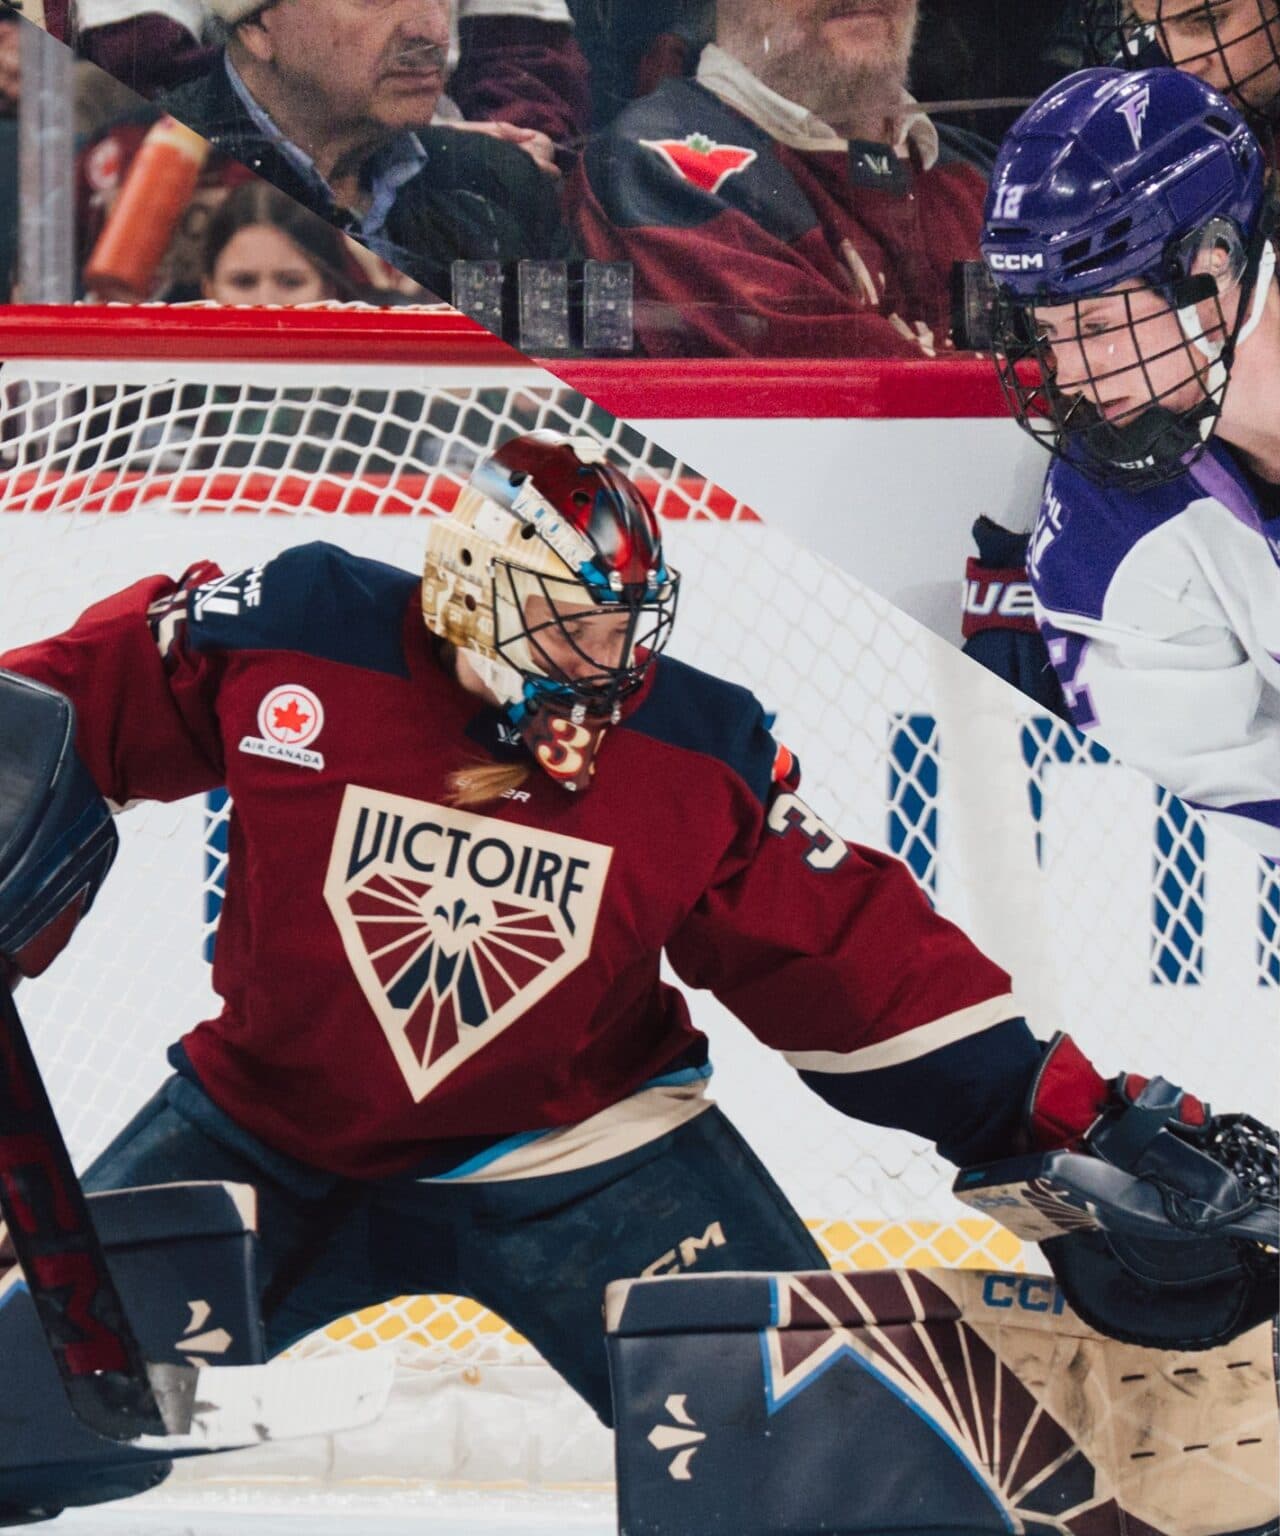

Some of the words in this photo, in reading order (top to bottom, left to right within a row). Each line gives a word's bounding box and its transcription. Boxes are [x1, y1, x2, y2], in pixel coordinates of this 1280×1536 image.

[991, 184, 1025, 218] 12
[989, 253, 1044, 270] CCM
[244, 741, 265, 751] AIR
[267, 745, 320, 764] CANADA
[538, 718, 604, 776] 3
[345, 806, 591, 938] VICTOIRE
[982, 1274, 1067, 1316] CC
